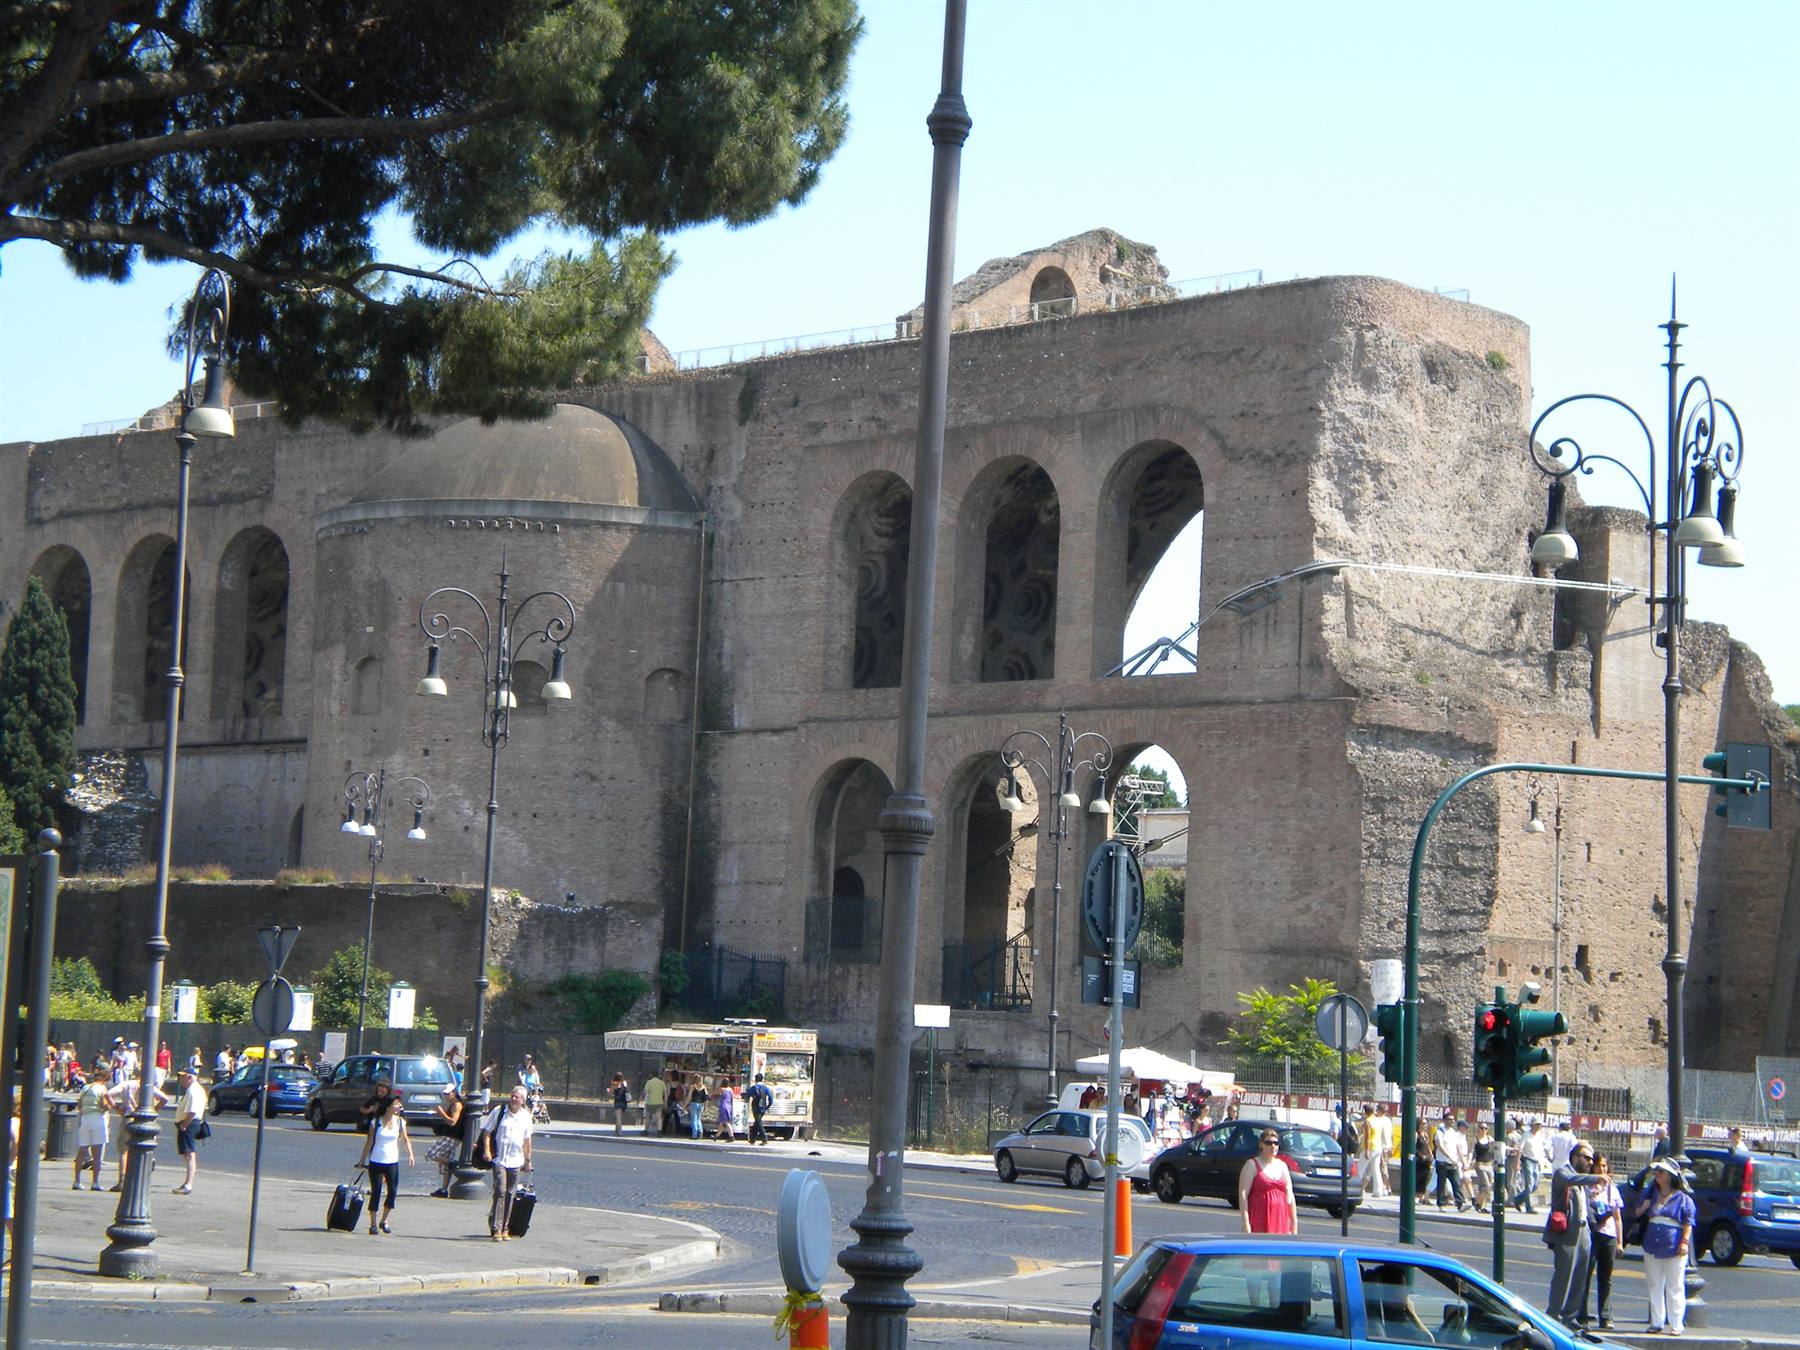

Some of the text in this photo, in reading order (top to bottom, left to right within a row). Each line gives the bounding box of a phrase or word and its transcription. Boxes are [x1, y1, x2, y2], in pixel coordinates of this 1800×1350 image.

[1240, 1092, 1261, 1105] LAVORI
[1261, 1093, 1279, 1107] LINEA
[1423, 1105, 1443, 1120] LINEA
[1599, 1118, 1631, 1133] LAVORI
[1633, 1120, 1658, 1135] LINEA
[1702, 1124, 1728, 1139] ROMA
